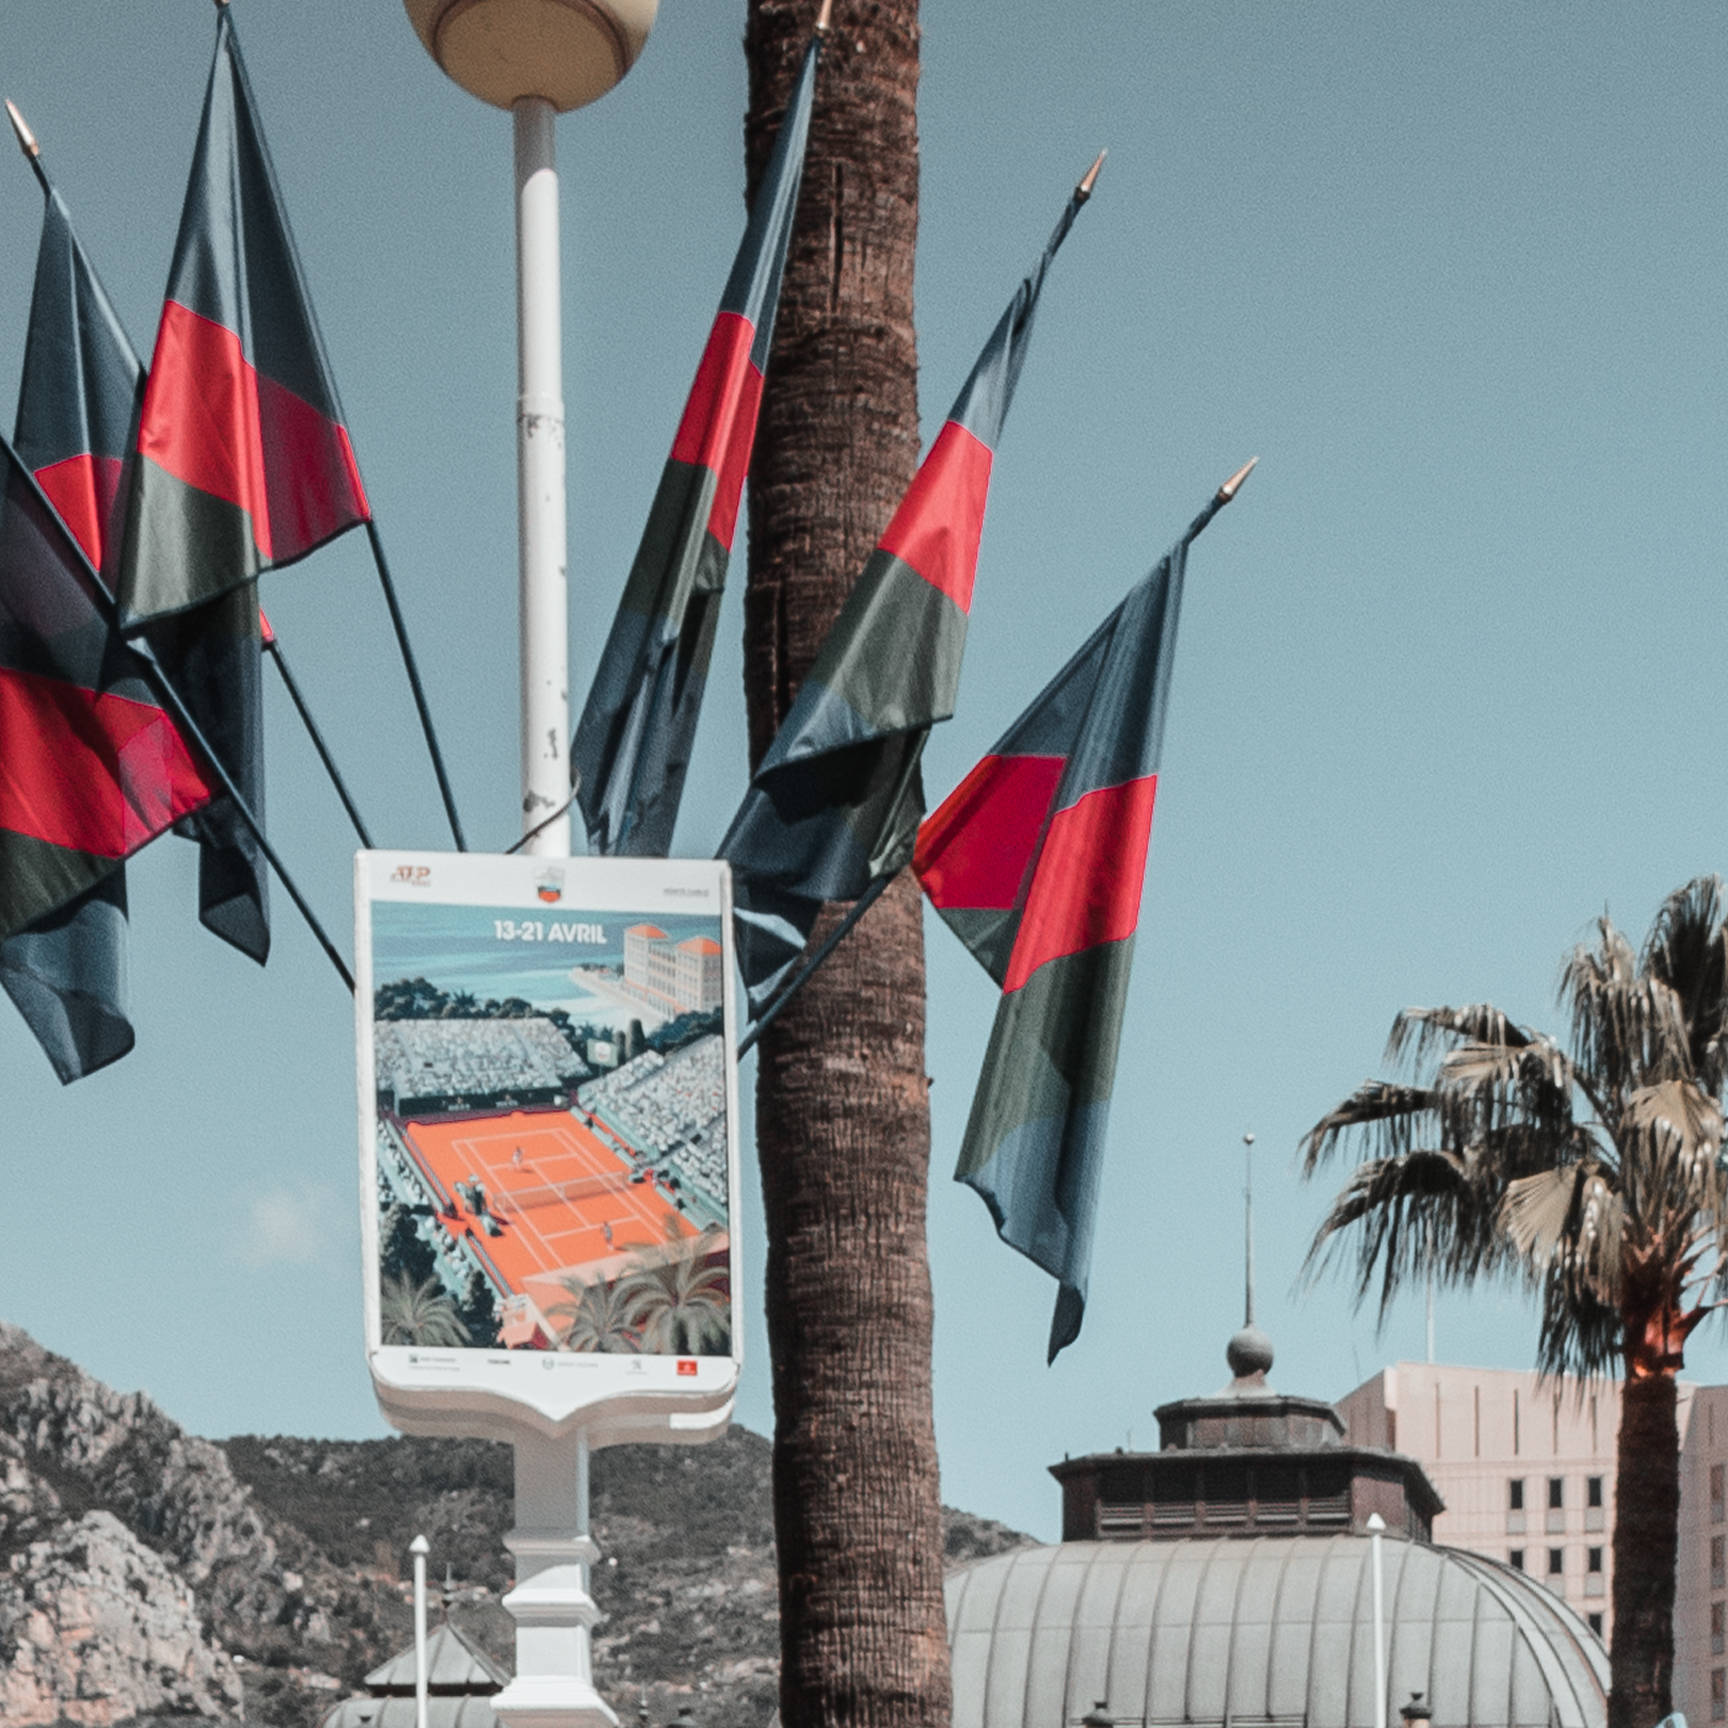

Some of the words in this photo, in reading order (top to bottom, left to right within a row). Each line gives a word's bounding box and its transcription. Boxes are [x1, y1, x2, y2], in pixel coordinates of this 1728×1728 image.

[390, 865, 430, 880] ATP
[494, 919, 543, 941] 13-21
[547, 922, 607, 944] AVRIL
